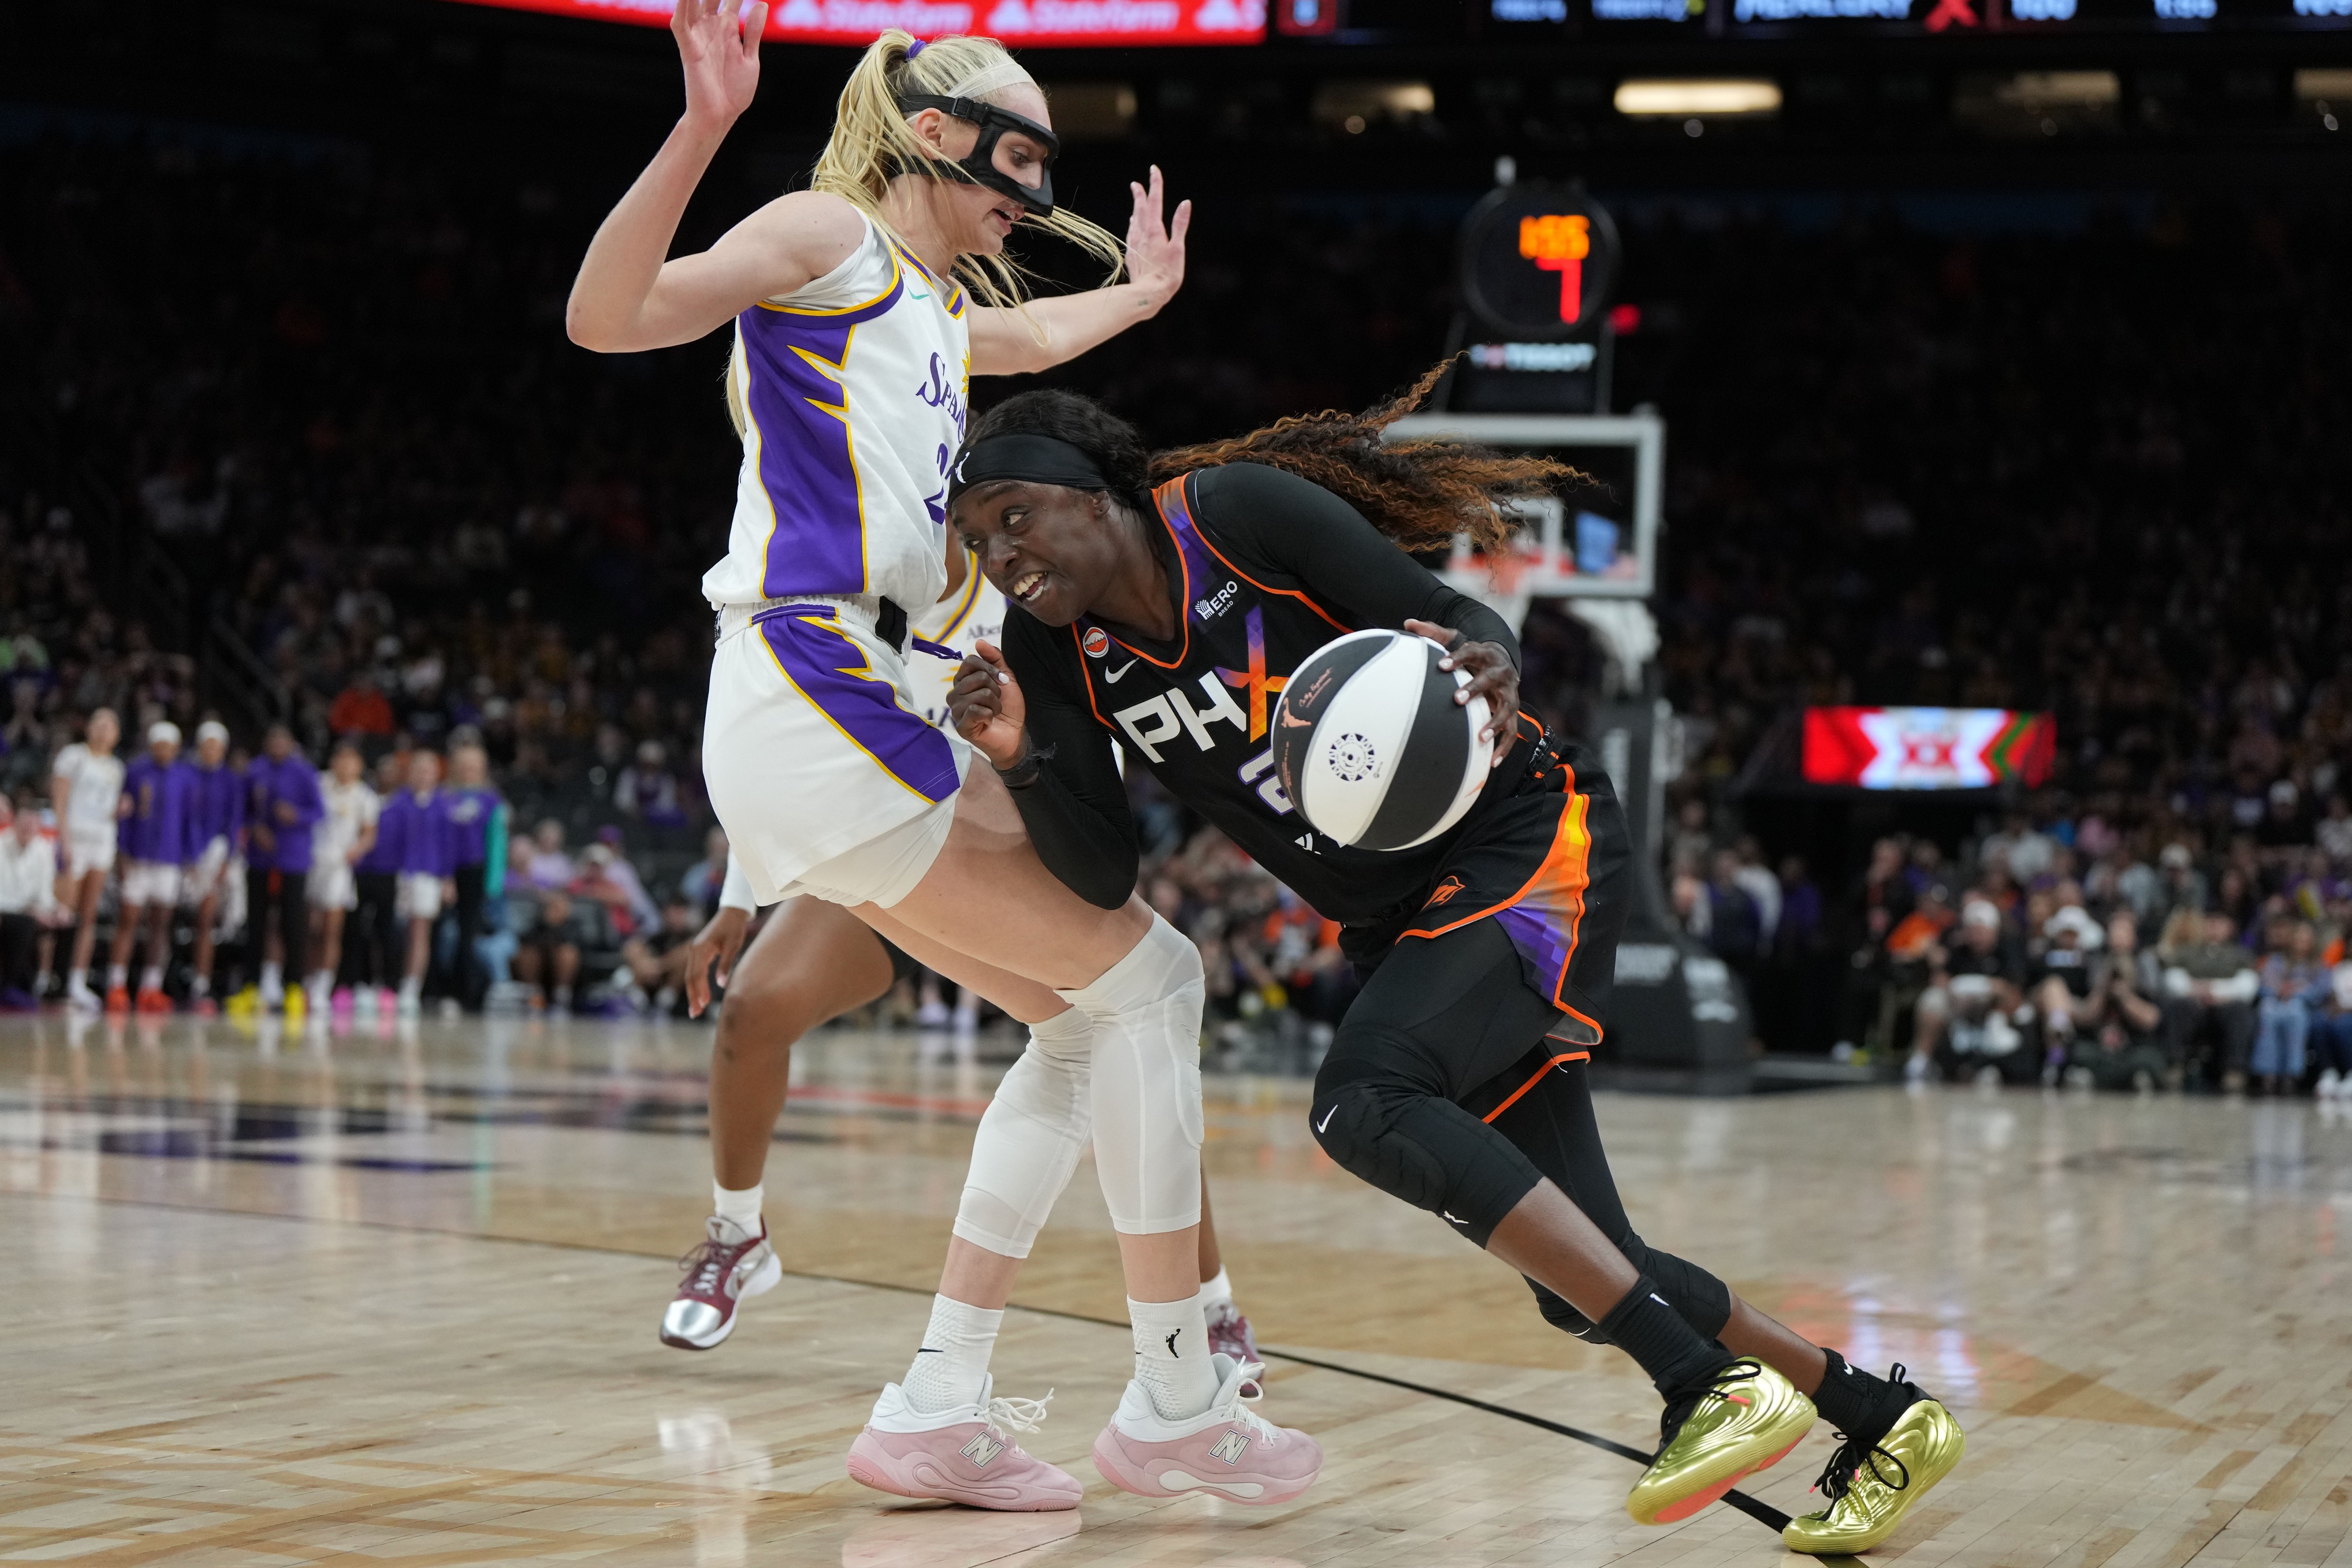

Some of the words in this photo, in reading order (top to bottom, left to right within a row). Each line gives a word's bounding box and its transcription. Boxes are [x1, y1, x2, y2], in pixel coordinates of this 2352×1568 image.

[1194, 580, 1238, 620] HERO
[1218, 600, 1234, 617] BREAD
[1112, 605, 1290, 763] PHX
